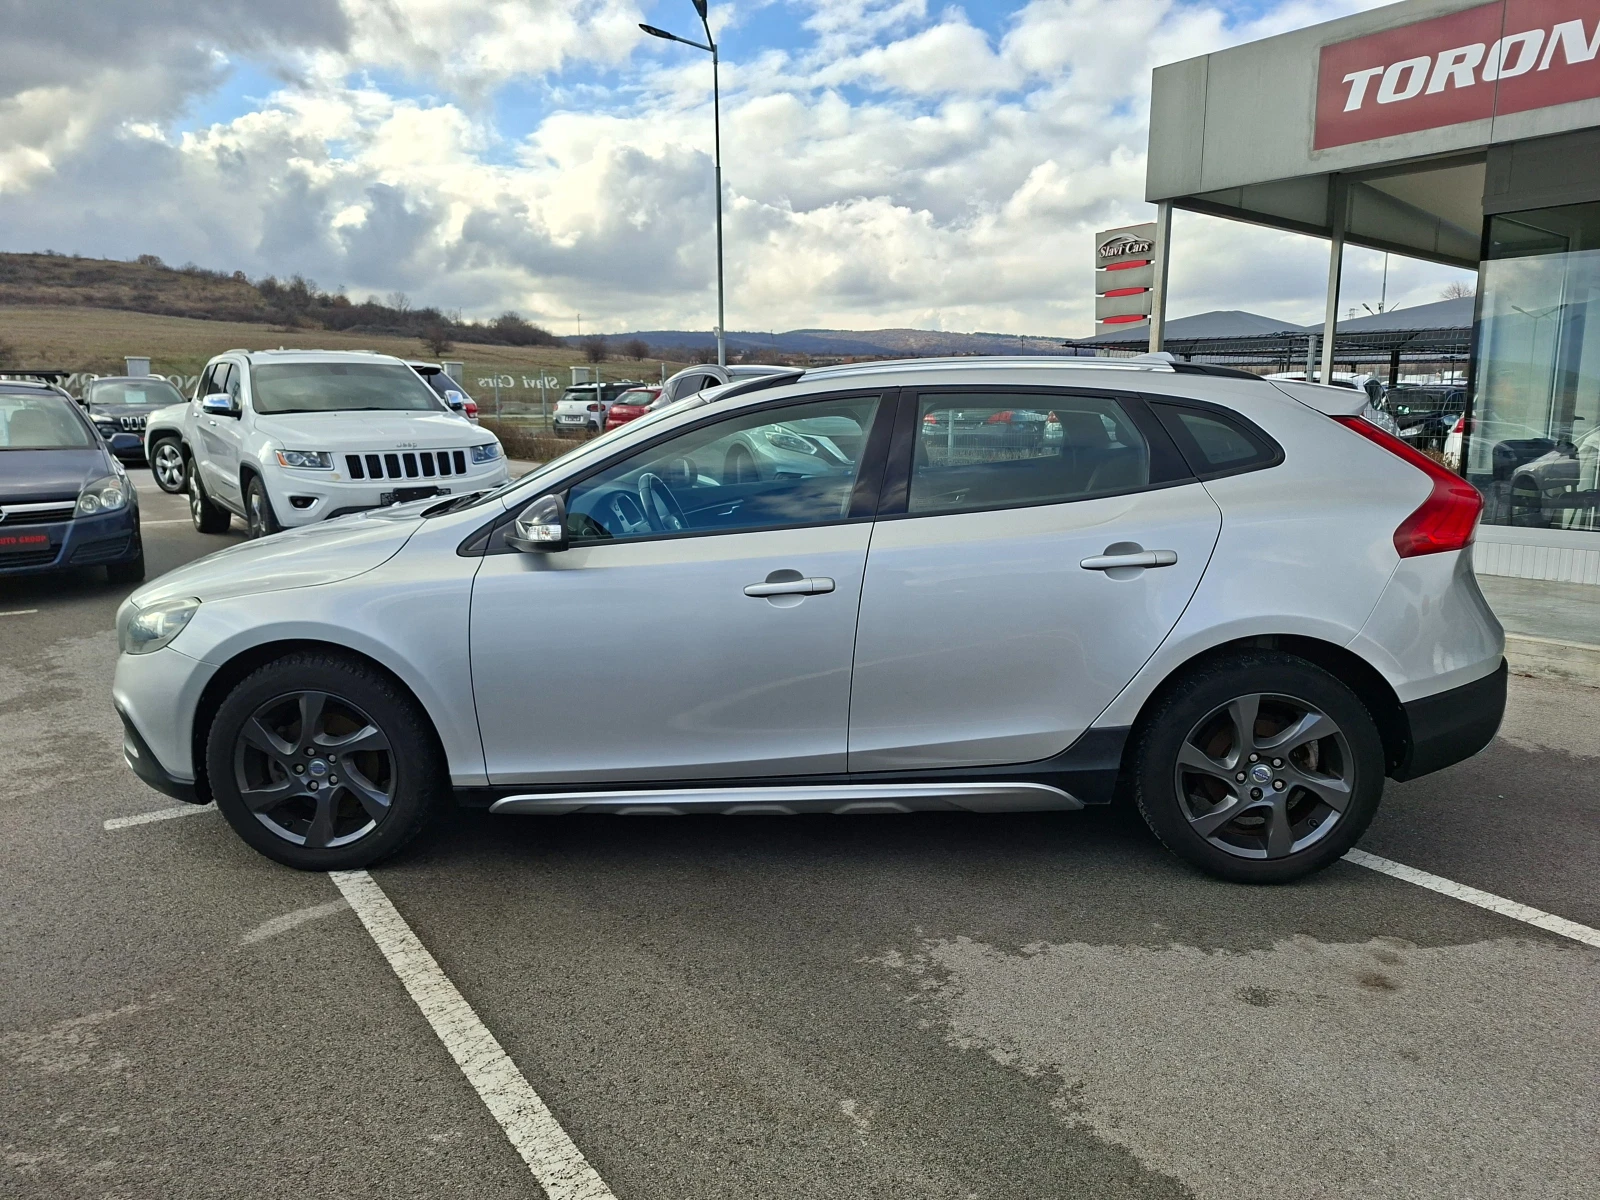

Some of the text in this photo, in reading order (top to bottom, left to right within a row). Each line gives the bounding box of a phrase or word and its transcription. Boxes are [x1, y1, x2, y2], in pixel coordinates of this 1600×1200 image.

[1342, 19, 1600, 113] TORON
[1099, 242, 1149, 258] Slavi Cars
[396, 441, 418, 449] Jeep
[19, 535, 46, 543] GROUP
